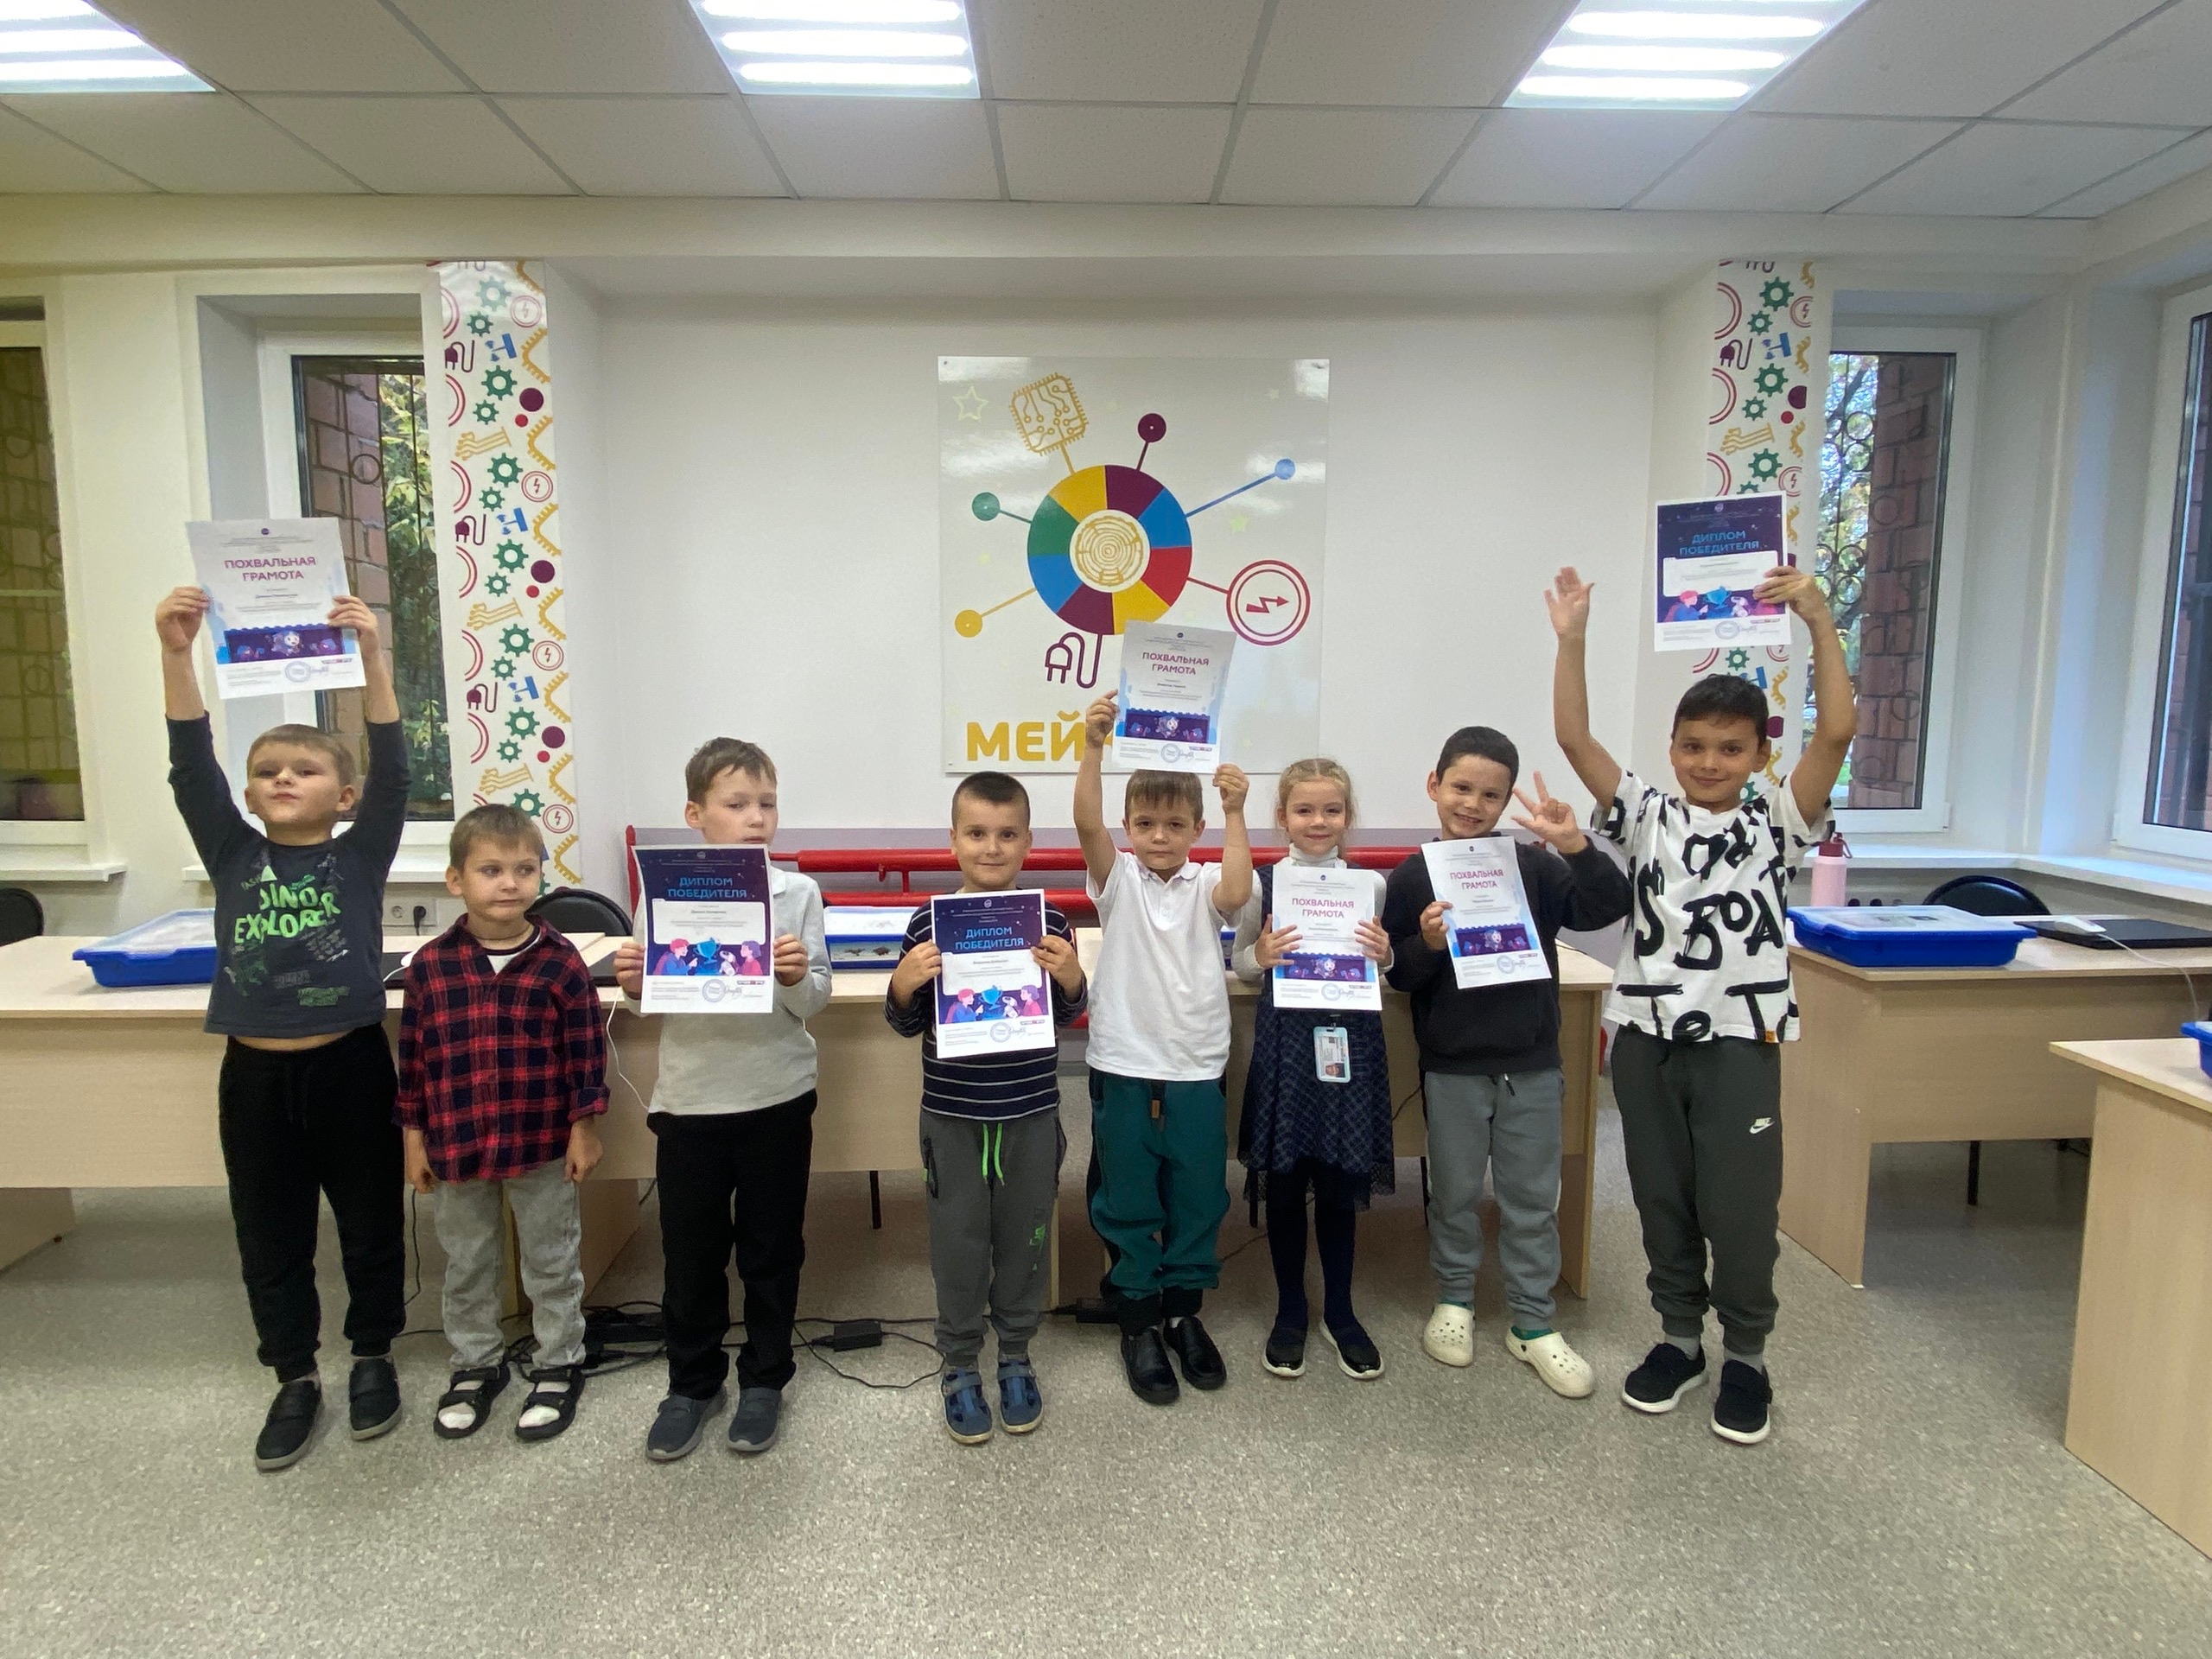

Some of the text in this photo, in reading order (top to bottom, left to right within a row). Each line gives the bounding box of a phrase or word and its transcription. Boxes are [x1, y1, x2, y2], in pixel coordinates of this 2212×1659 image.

[1692, 531, 1746, 544] ДИПЛОМ
[1680, 541, 1759, 555] ПОБЕДИТЕЛЯ
[224, 556, 316, 569] ПОХВАЛЬНАЯ
[242, 570, 304, 582] ГРАМОТА
[1141, 652, 1209, 666] ПОХВАЛЬНАЯ
[1152, 664, 1197, 675] ГРАМОТА
[967, 710, 1112, 761] МЕЙ
[1449, 869, 1504, 880] ПОХВАЛЬНАЯ
[679, 877, 734, 887] ДИПЛОМ
[1461, 880, 1497, 890] ГРАМОТА
[668, 889, 747, 899] ПОБЕДИТЕЛЯ
[1292, 898, 1355, 908] ПОХВАЛЬНАЯ
[234, 893, 341, 944] EXPLORER
[1302, 908, 1344, 918] ГРАМОТА
[965, 926, 1012, 939] ДИПЛОМ
[955, 938, 1024, 950] ПОБЕДИТЕЛЯ
